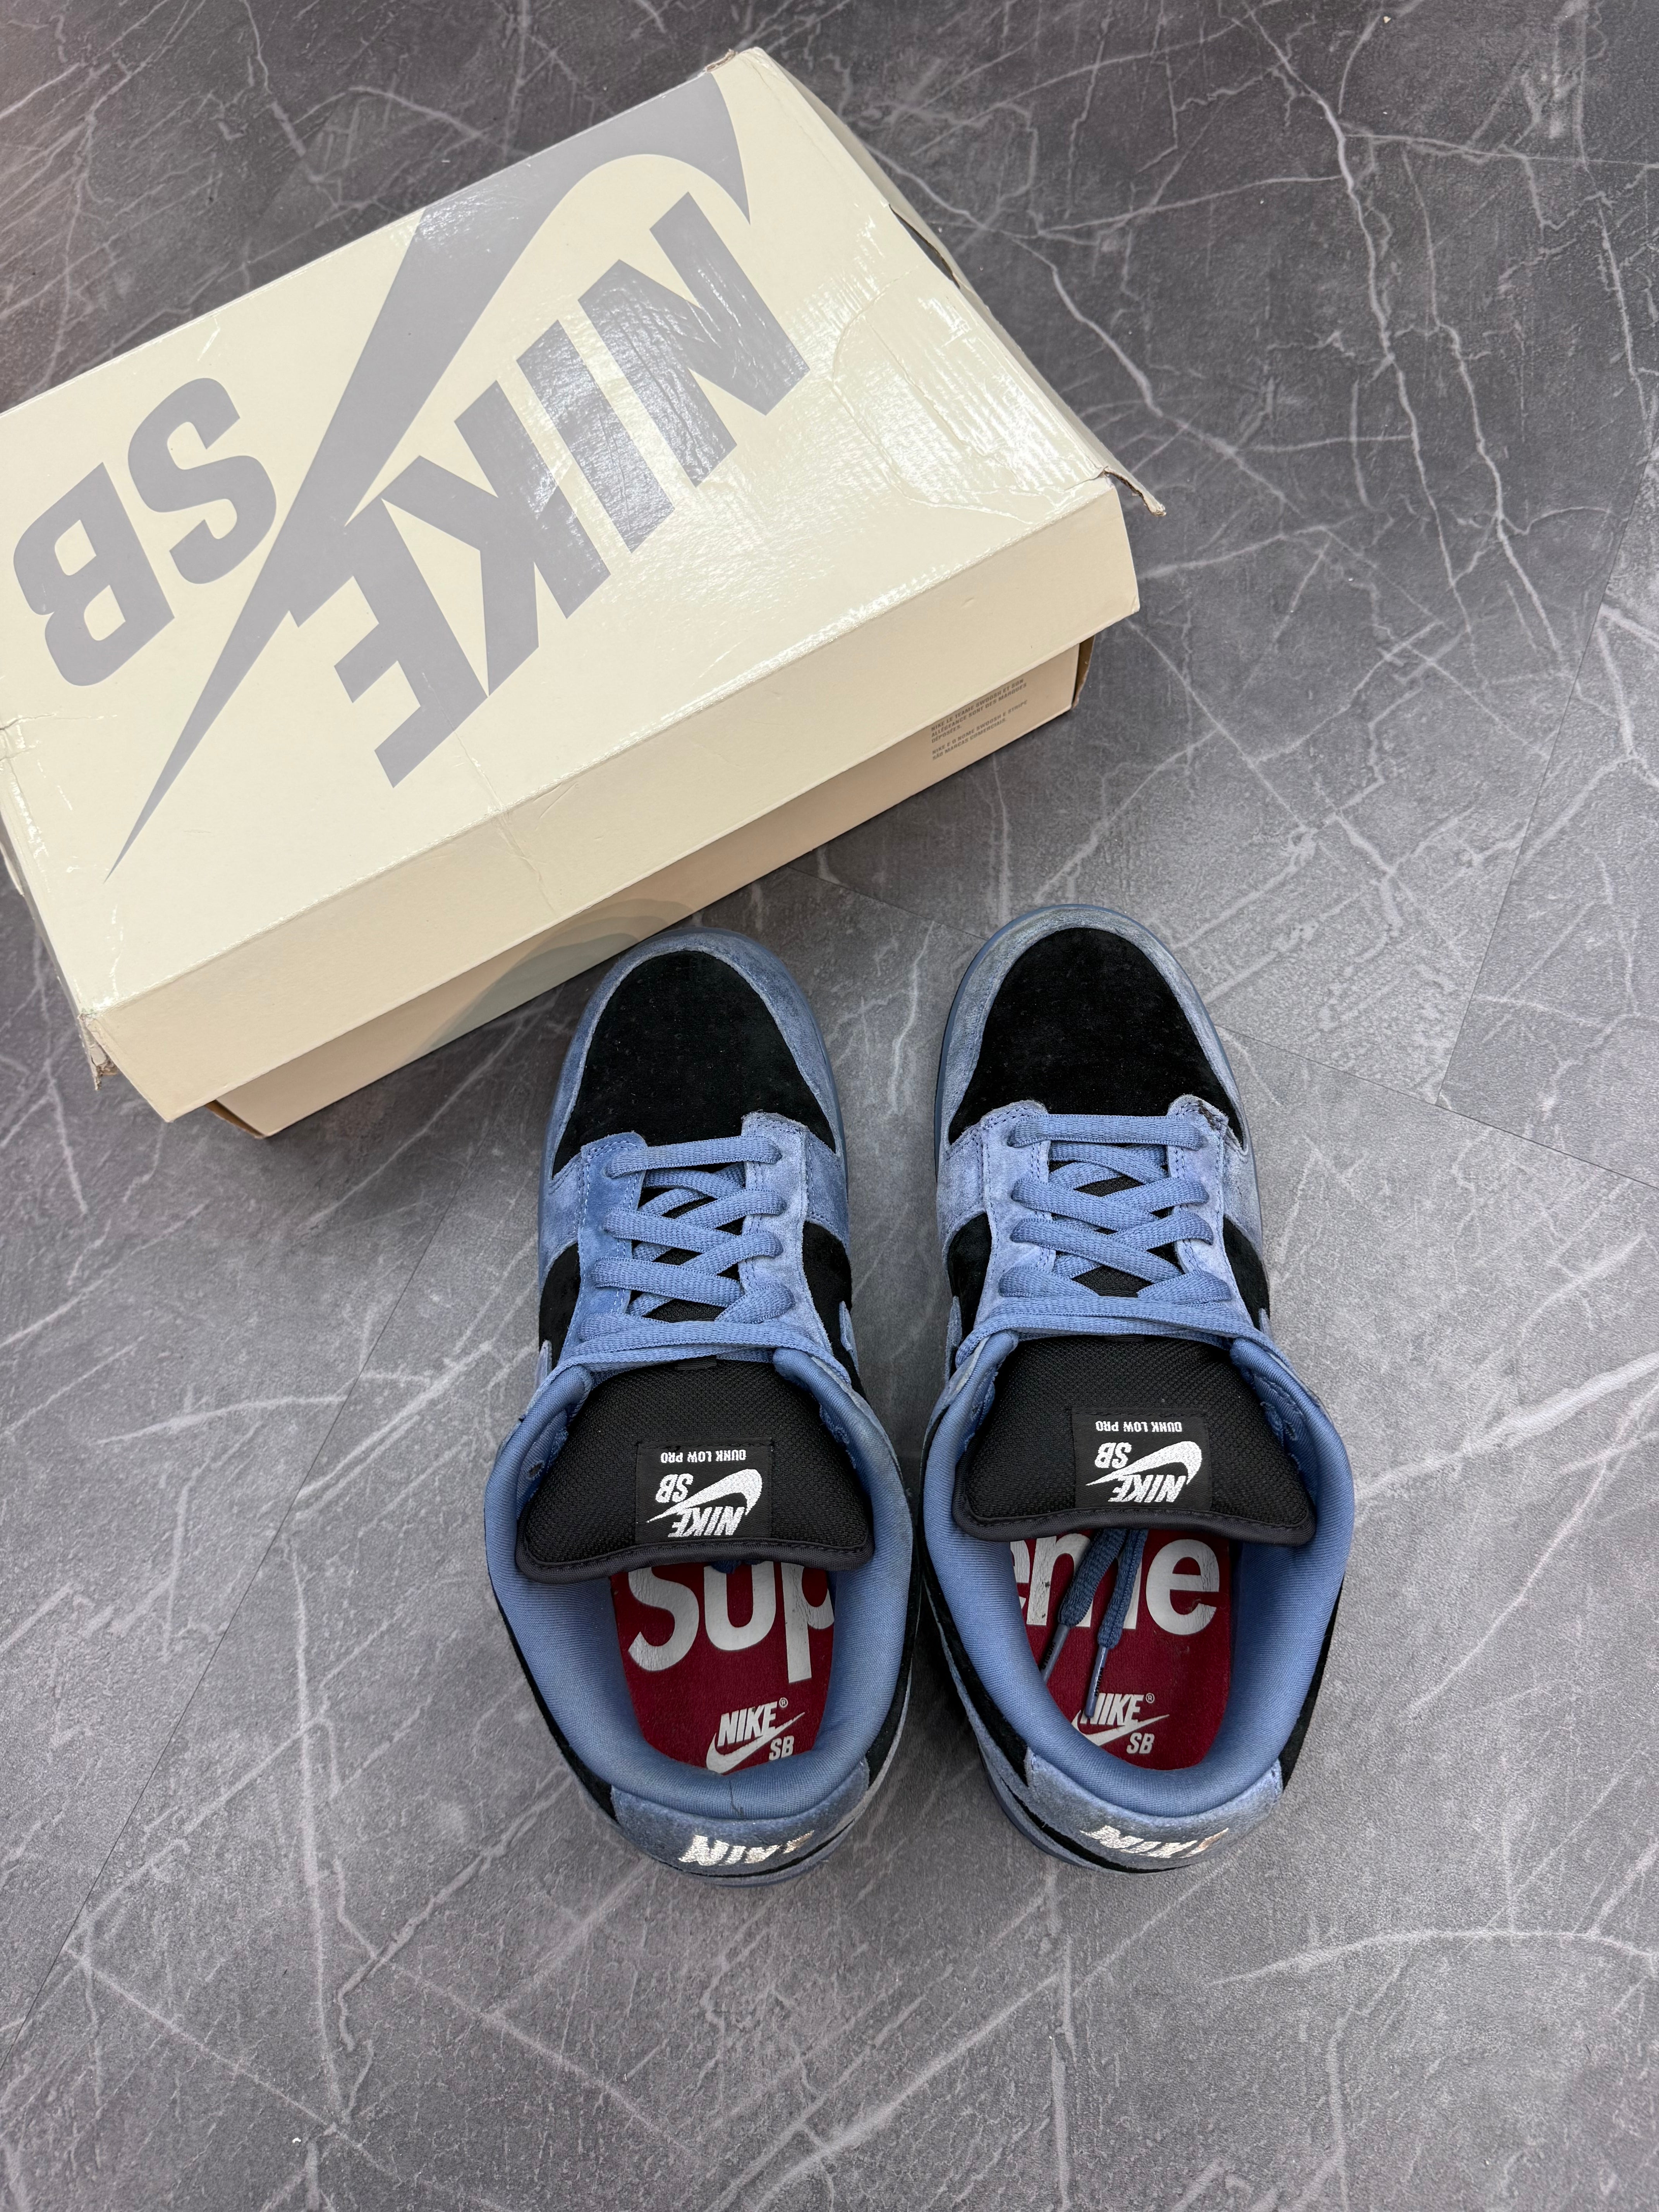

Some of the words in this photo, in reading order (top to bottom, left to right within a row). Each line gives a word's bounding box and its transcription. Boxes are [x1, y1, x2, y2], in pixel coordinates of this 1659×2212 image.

[290, 192, 810, 788] NIKE
[13, 378, 276, 686] SB
[931, 723, 945, 731] NIKE
[976, 691, 1001, 707] SWOOSH
[1012, 679, 1024, 688] SON
[969, 708, 984, 718] SONT
[985, 700, 996, 708] DES
[998, 683, 1027, 701] MARQUES
[933, 746, 945, 754] NIKE
[958, 728, 974, 741] NOME
[977, 714, 1001, 731] SWOOSH
[945, 738, 968, 752] MARCAS
[1096, 1421, 1119, 1432] PRO
[1123, 1421, 1147, 1432] LOW
[1151, 1422, 1182, 1432] DUNK
[661, 1452, 683, 1463] PRO
[688, 1451, 711, 1462] LOW
[715, 1449, 746, 1461] DUNK
[1094, 1442, 1132, 1469] SB
[655, 1474, 694, 1503] SB
[1108, 1474, 1185, 1503] NIKE
[668, 1506, 745, 1537] NIKE
[769, 1736, 794, 1760] SB
[1127, 1733, 1155, 1753] SB
